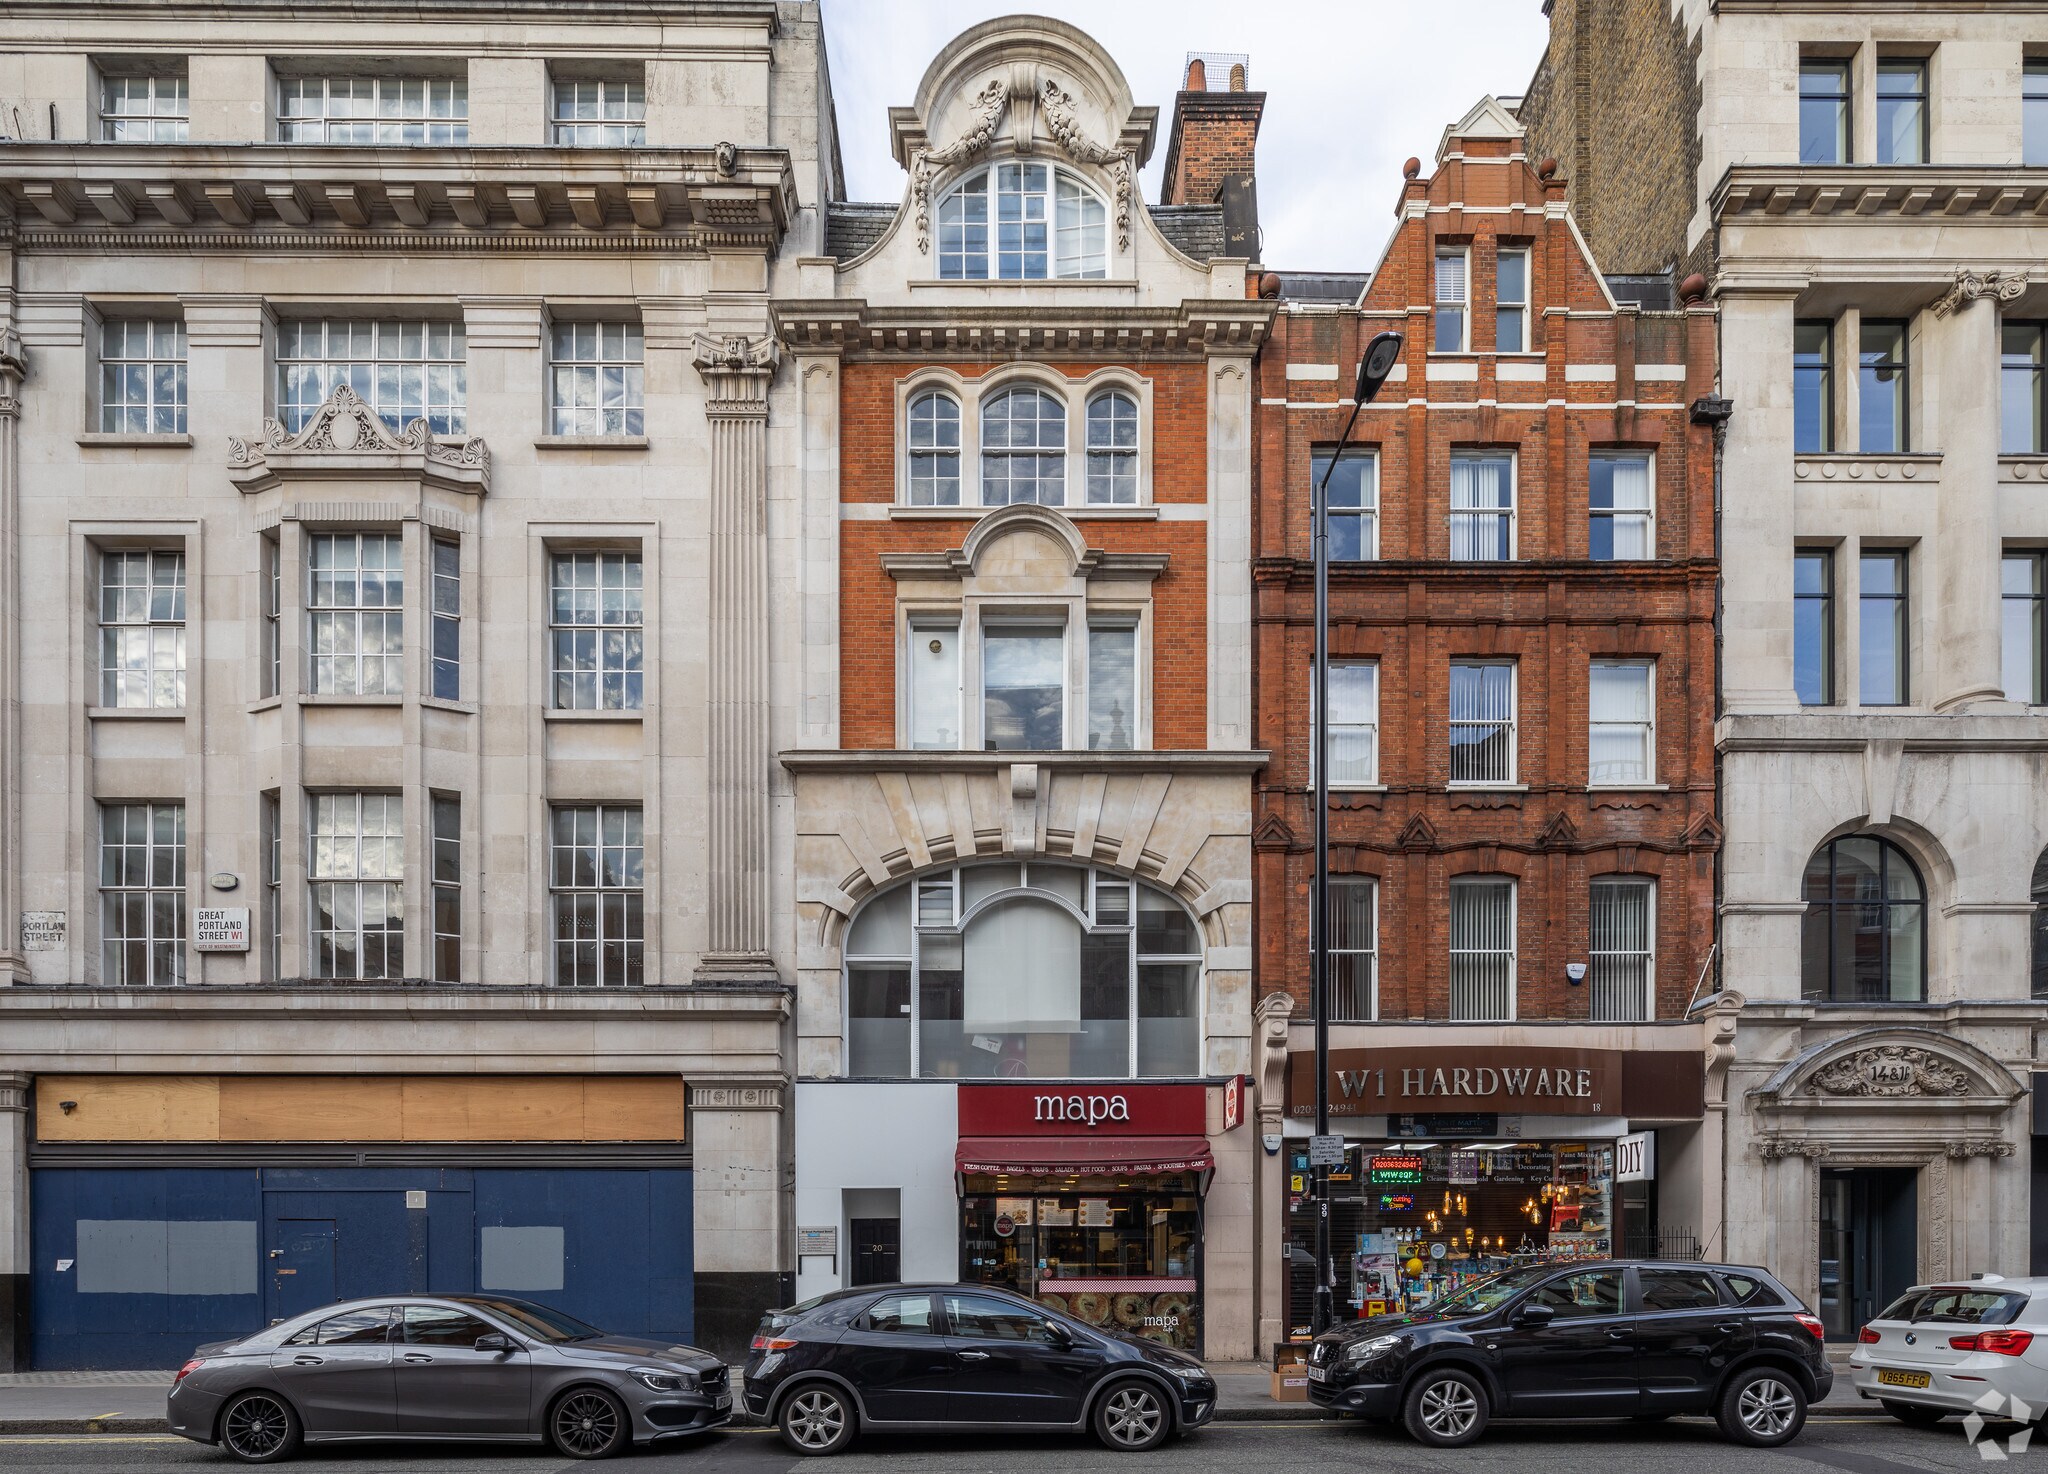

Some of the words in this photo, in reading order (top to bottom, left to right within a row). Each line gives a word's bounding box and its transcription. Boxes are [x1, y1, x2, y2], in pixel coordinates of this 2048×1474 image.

[198, 911, 225, 920] GREAT
[198, 921, 242, 930] PORTLAND
[198, 931, 229, 940] STREET
[230, 931, 243, 940] W1
[1335, 1069, 1386, 1098] W1
[1401, 1068, 1591, 1098] HARDWARE
[1034, 1095, 1130, 1126] mapa
[1593, 1103, 1601, 1113] 18
[1619, 1140, 1644, 1175] DIY
[980, 1164, 1000, 1172] COFFEE
[1157, 1162, 1186, 1170] SMOOTHIES
[1517, 1164, 1552, 1173] Decorating
[1493, 1175, 1525, 1184] Gardening
[1530, 1175, 1543, 1184] Key
[1382, 1195, 1393, 1204] Key
[1393, 1196, 1412, 1204] cutting
[872, 1244, 883, 1252] 20
[1144, 1310, 1179, 1328] mapa
[1882, 1371, 1904, 1383] YB65
[1905, 1374, 1926, 1386] FFG
